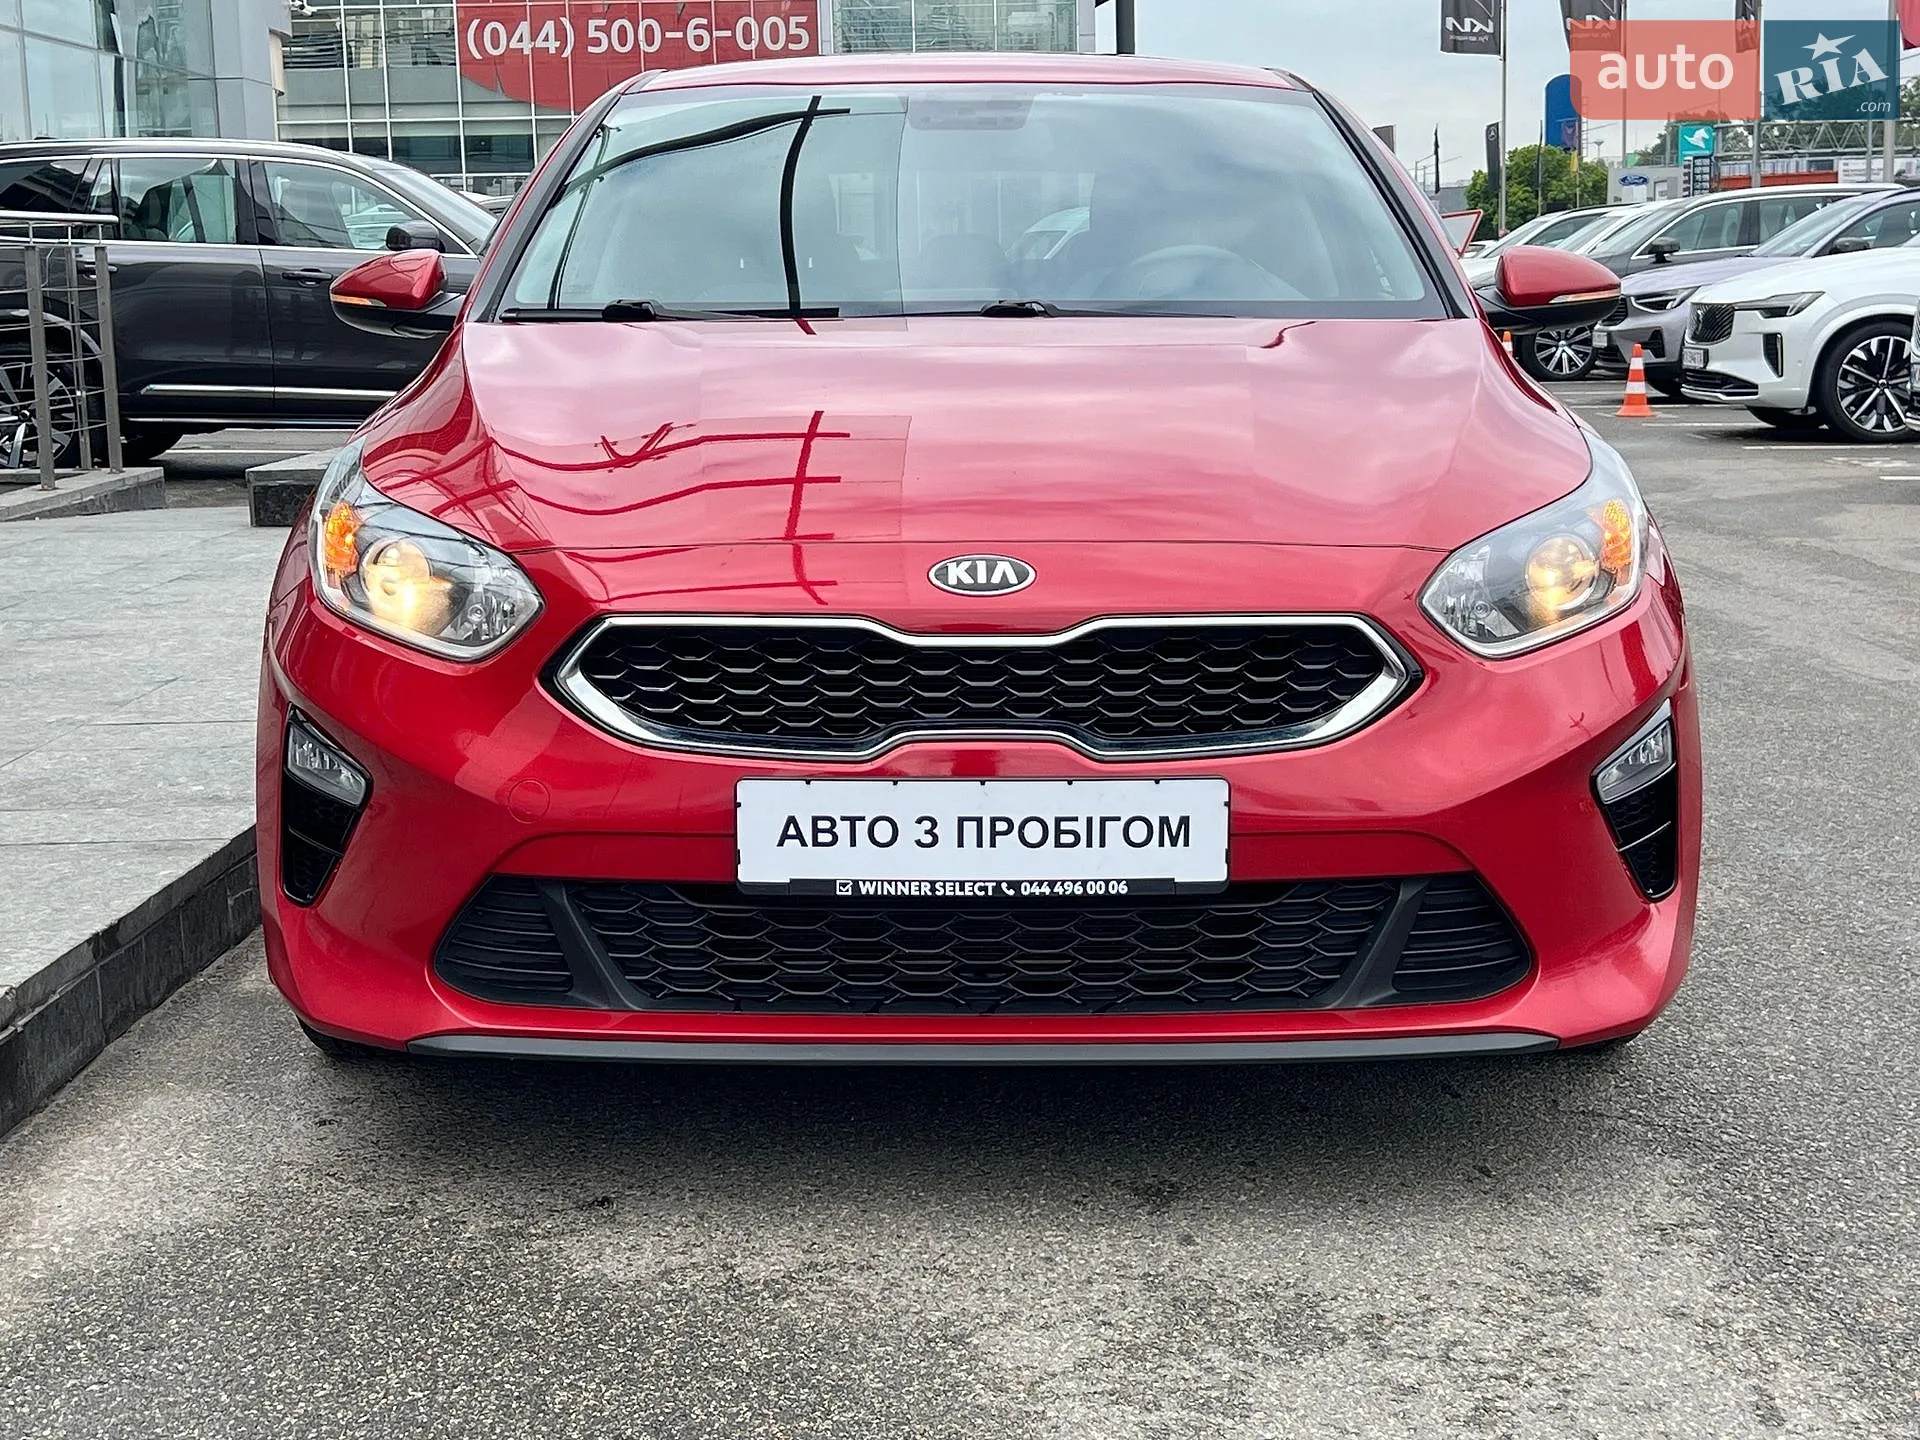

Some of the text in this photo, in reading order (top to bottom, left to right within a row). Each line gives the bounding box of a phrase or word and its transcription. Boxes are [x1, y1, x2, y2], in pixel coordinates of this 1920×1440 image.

[466, 15, 810, 59] (044) 500-6-005
[946, 560, 1018, 585] KIA
[776, 815, 899, 848] АВТО
[956, 815, 1191, 849] ПРОБІГОМ
[858, 880, 1128, 896] WINNER SELECT 044 496 00 06
